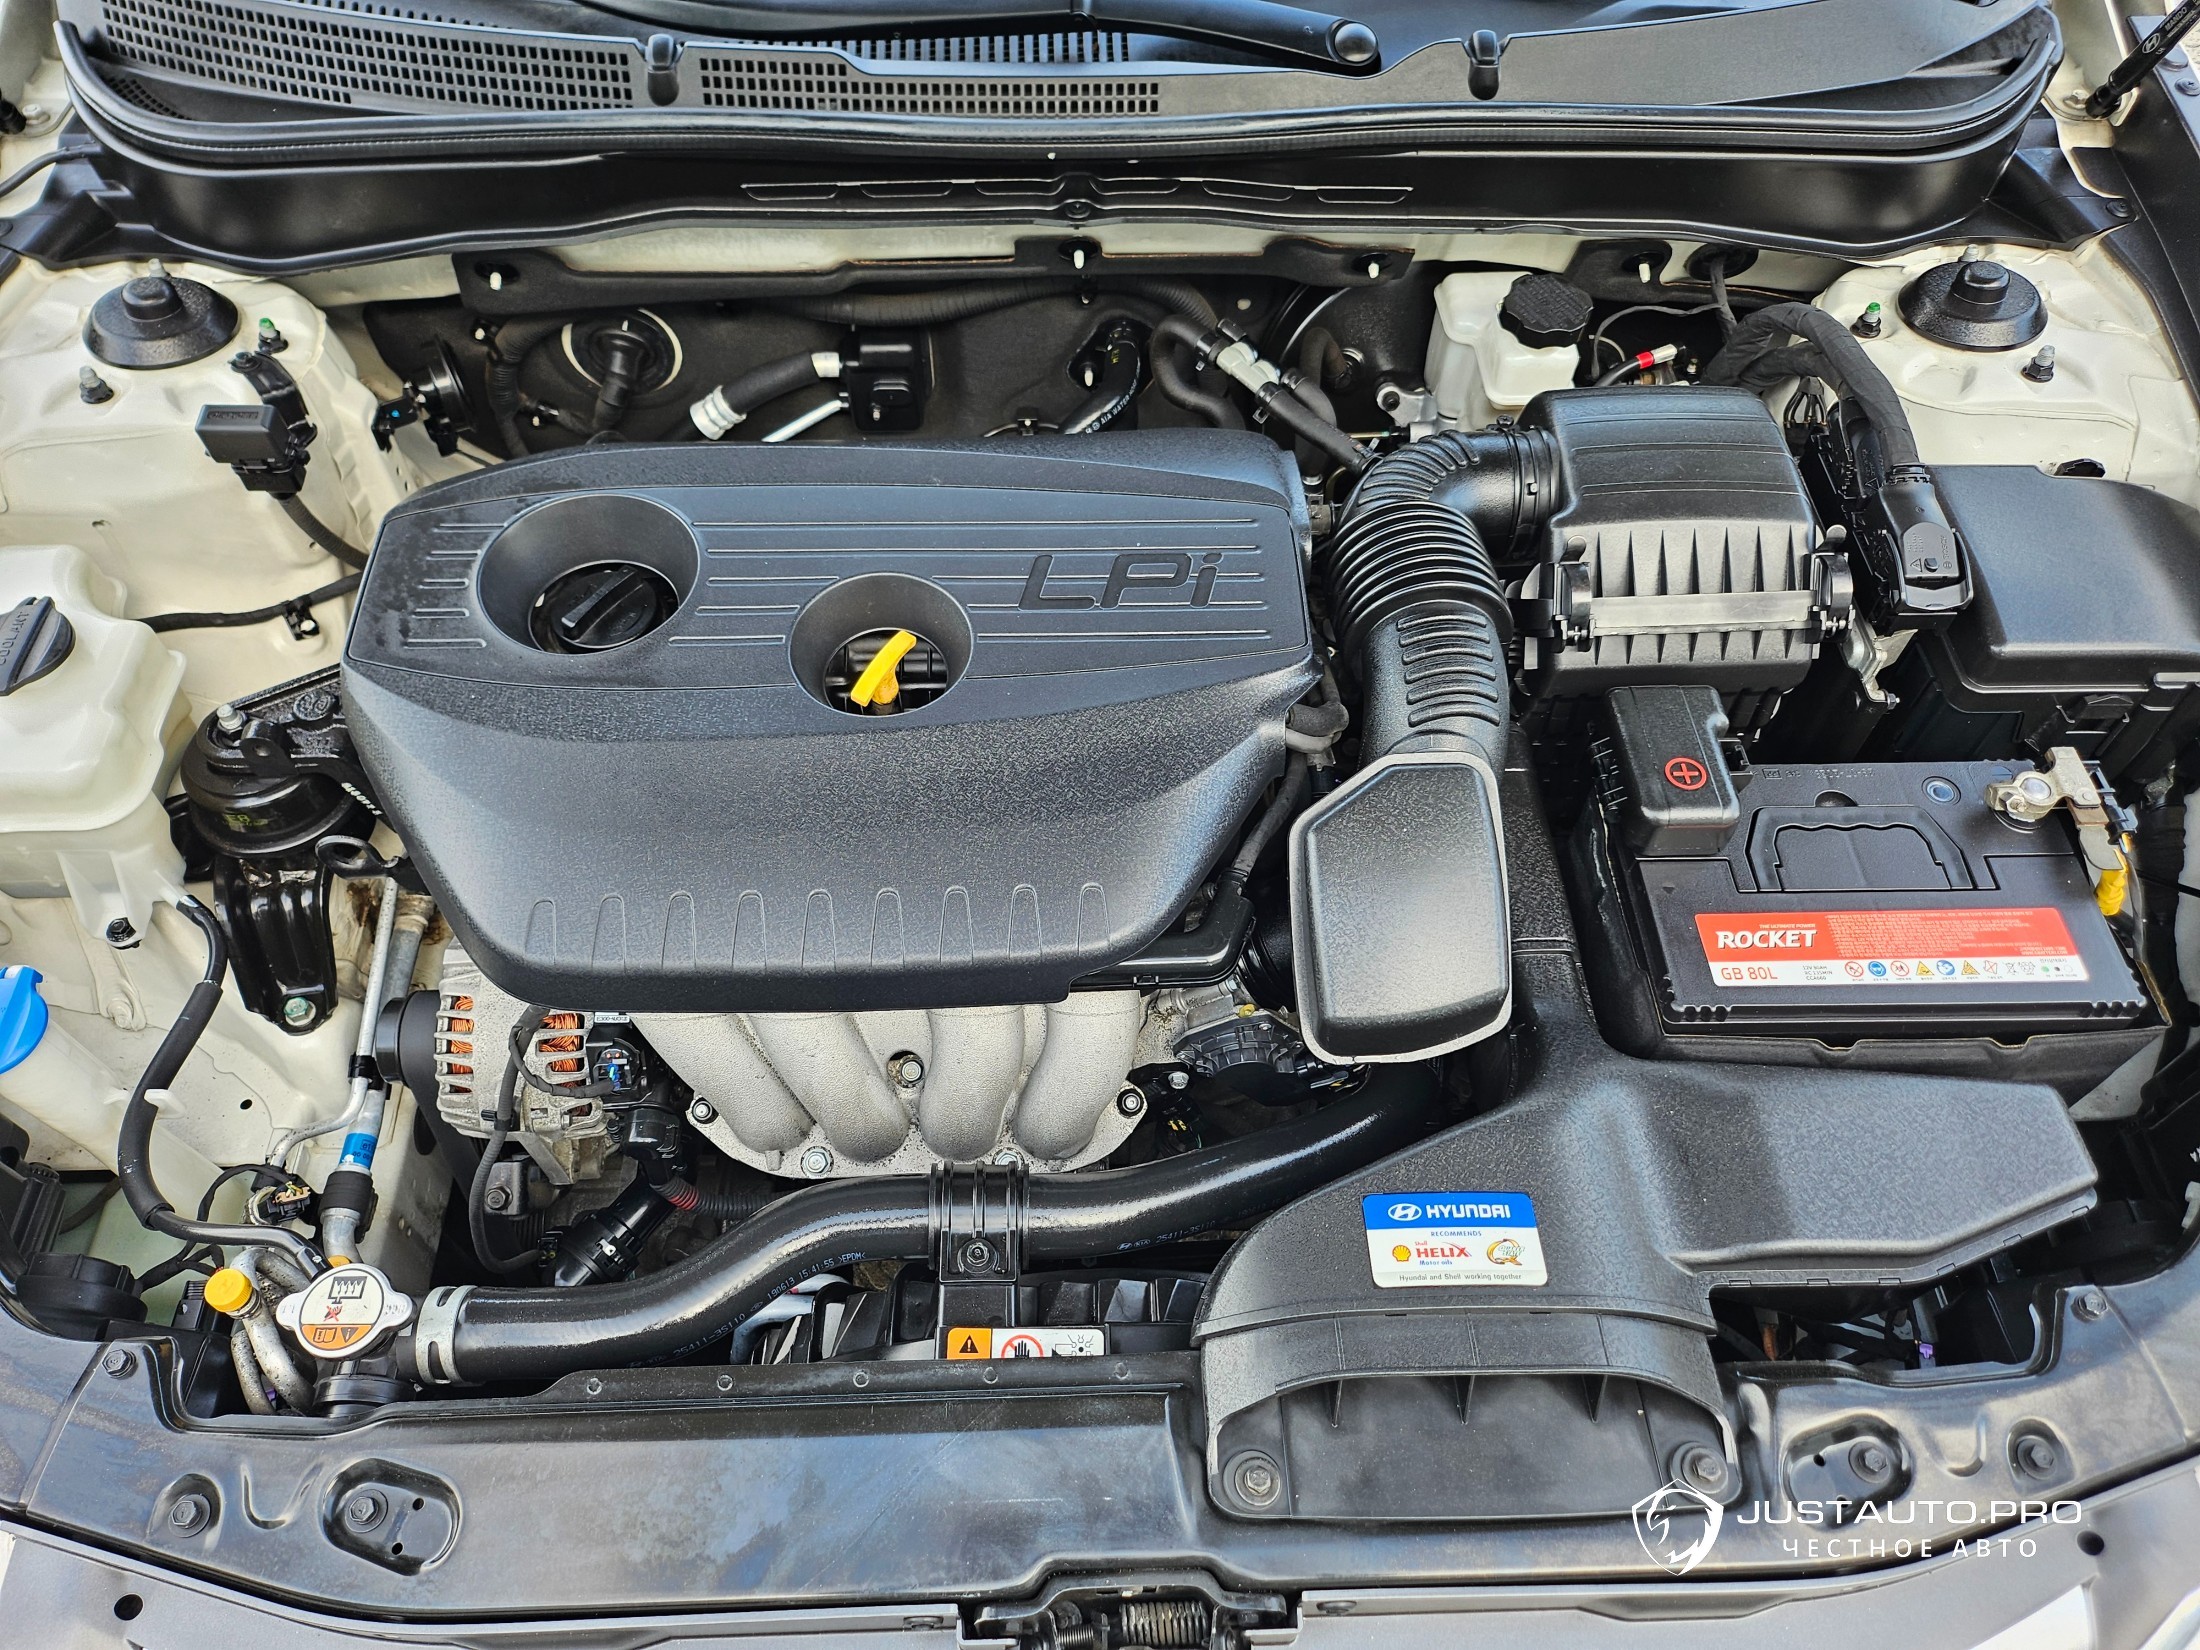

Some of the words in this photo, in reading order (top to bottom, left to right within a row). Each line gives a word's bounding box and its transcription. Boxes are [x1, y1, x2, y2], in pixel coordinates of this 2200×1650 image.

[2164, 6, 2188, 31] MANDO
[1112, 394, 1130, 415] WATER
[1715, 930, 1817, 949] ROCKET
[1721, 967, 1743, 980] GB
[1748, 966, 1778, 980] 80L
[1426, 1203, 1511, 1219] HYUNDAI
[1415, 1247, 1470, 1258] HELIX
[767, 1276, 796, 1301] 190613
[798, 1257, 835, 1280] 15:41:55
[1399, 1274, 1428, 1282] Hyundai
[1464, 1272, 1492, 1281] working
[1493, 1273, 1522, 1281] together
